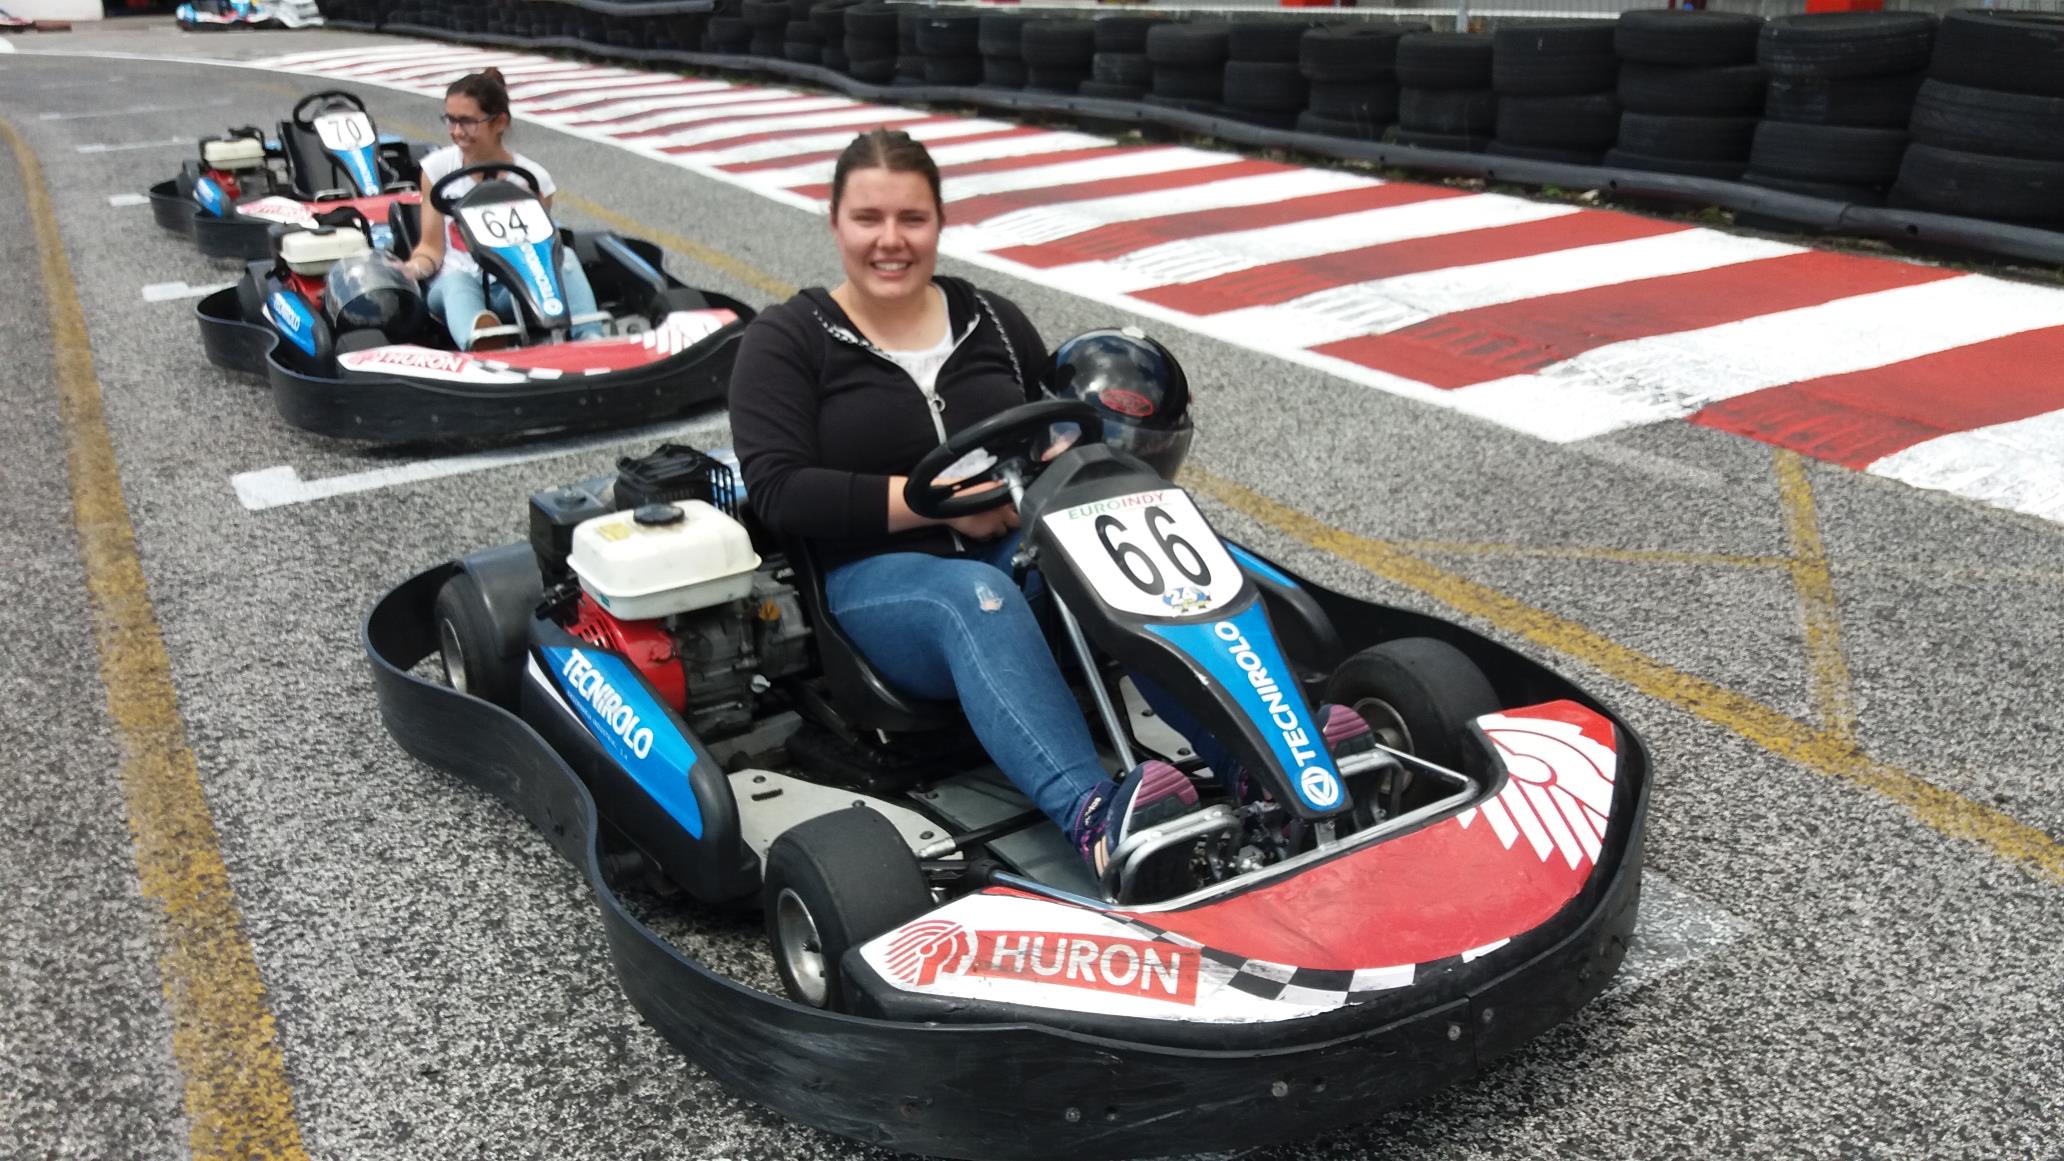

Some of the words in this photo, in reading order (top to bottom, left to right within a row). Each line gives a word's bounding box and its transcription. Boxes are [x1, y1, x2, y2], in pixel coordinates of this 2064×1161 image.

[328, 118, 362, 141] 70
[481, 207, 528, 239] 64
[1068, 492, 1166, 520] EUROINDY
[1094, 505, 1212, 596] 66
[563, 648, 654, 760] TECNIROLO
[1214, 621, 1316, 767] TECNIROLO
[991, 935, 1181, 995] HURON
